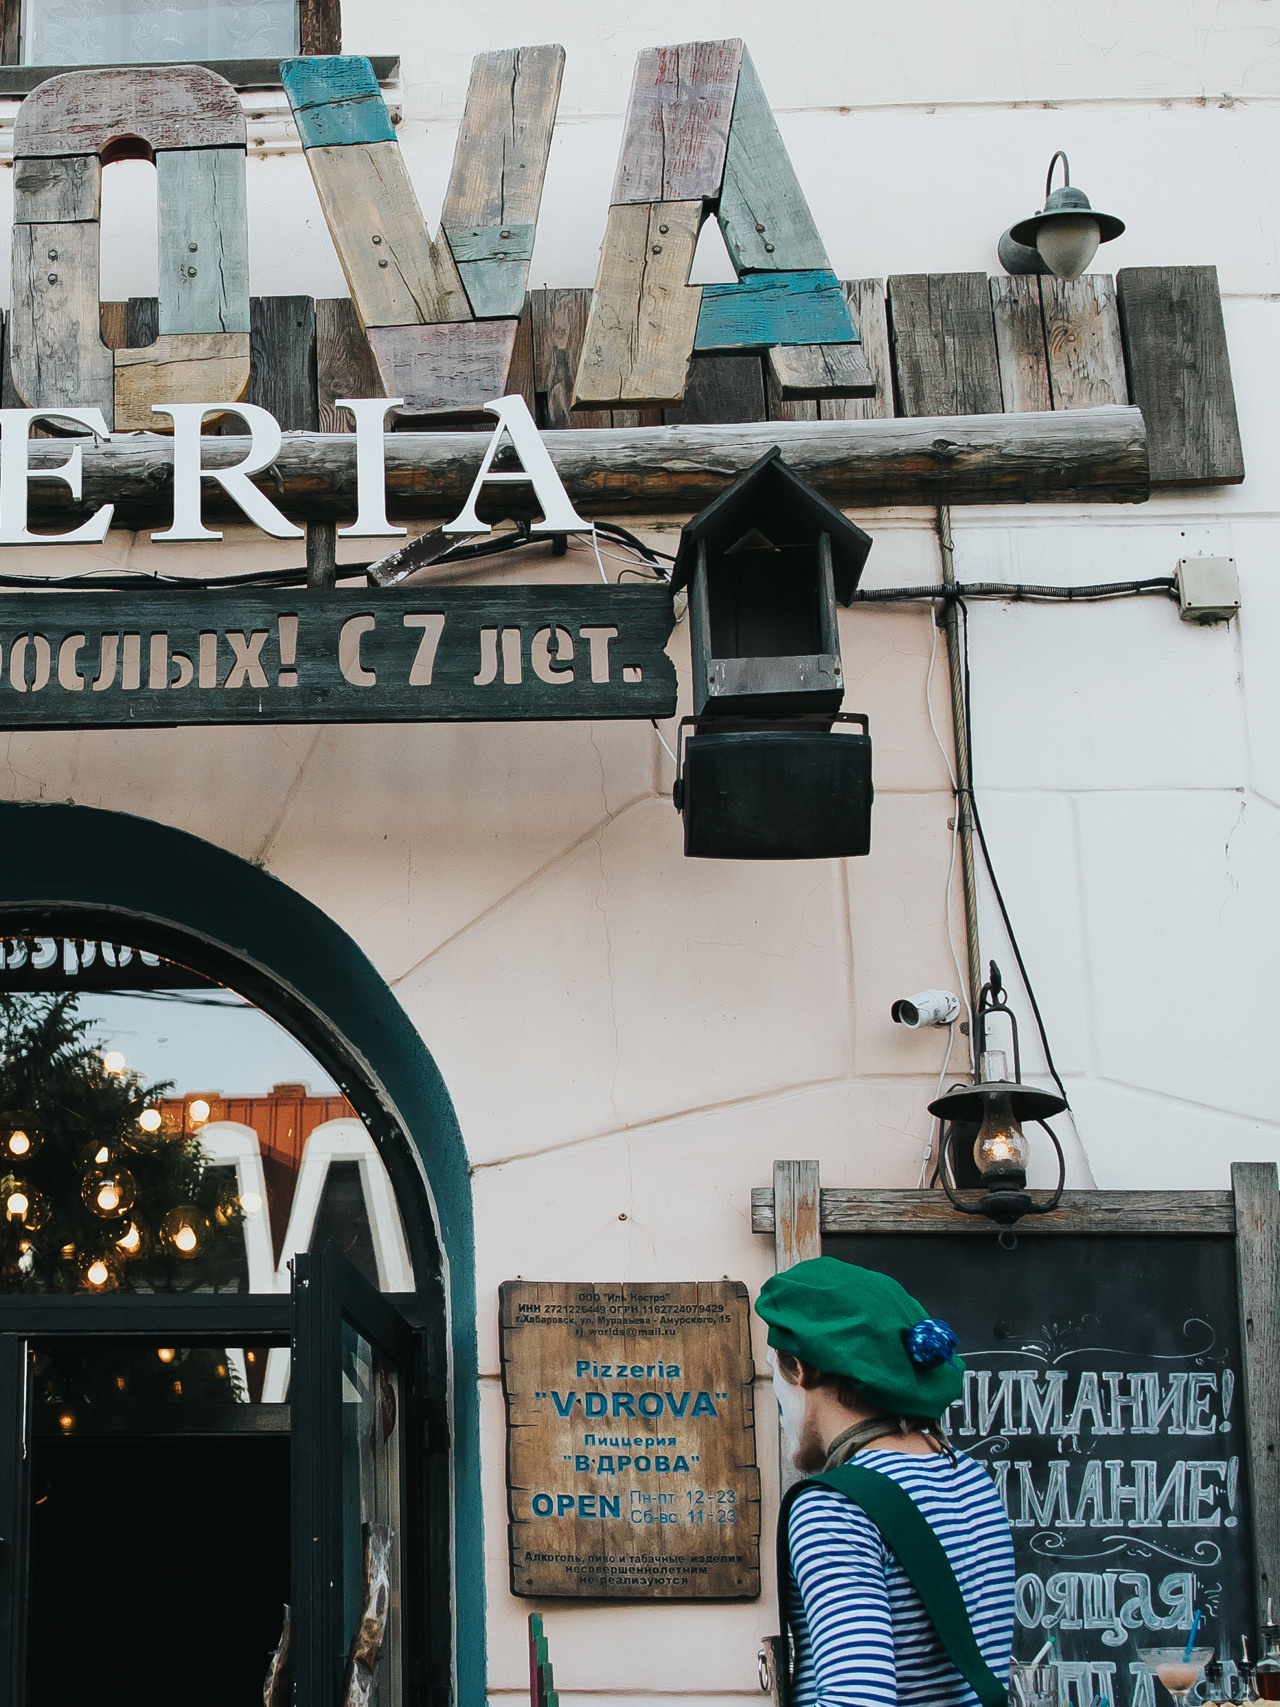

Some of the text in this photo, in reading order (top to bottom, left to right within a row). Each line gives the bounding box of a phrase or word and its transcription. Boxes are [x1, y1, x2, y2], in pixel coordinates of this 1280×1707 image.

[338, 611, 376, 687] С
[402, 610, 446, 687] 7
[473, 622, 643, 687] лет.
[518, 1304, 725, 1314] ИНН 2721226449 ОГРН 1162724079429
[720, 1315, 731, 1324] 15
[576, 1361, 681, 1379] Pizzeria
[584, 1434, 677, 1449] Пиццерия
[630, 1490, 675, 1505] Пн-пт
[532, 1493, 621, 1519] OPEN
[630, 1510, 677, 1525] Сб-вс
[524, 1552, 743, 1564] Алкоголь, пиво и табачные изделия
[566, 1565, 708, 1577] несовершеннолетним
[579, 1576, 689, 1587] не реализуются
